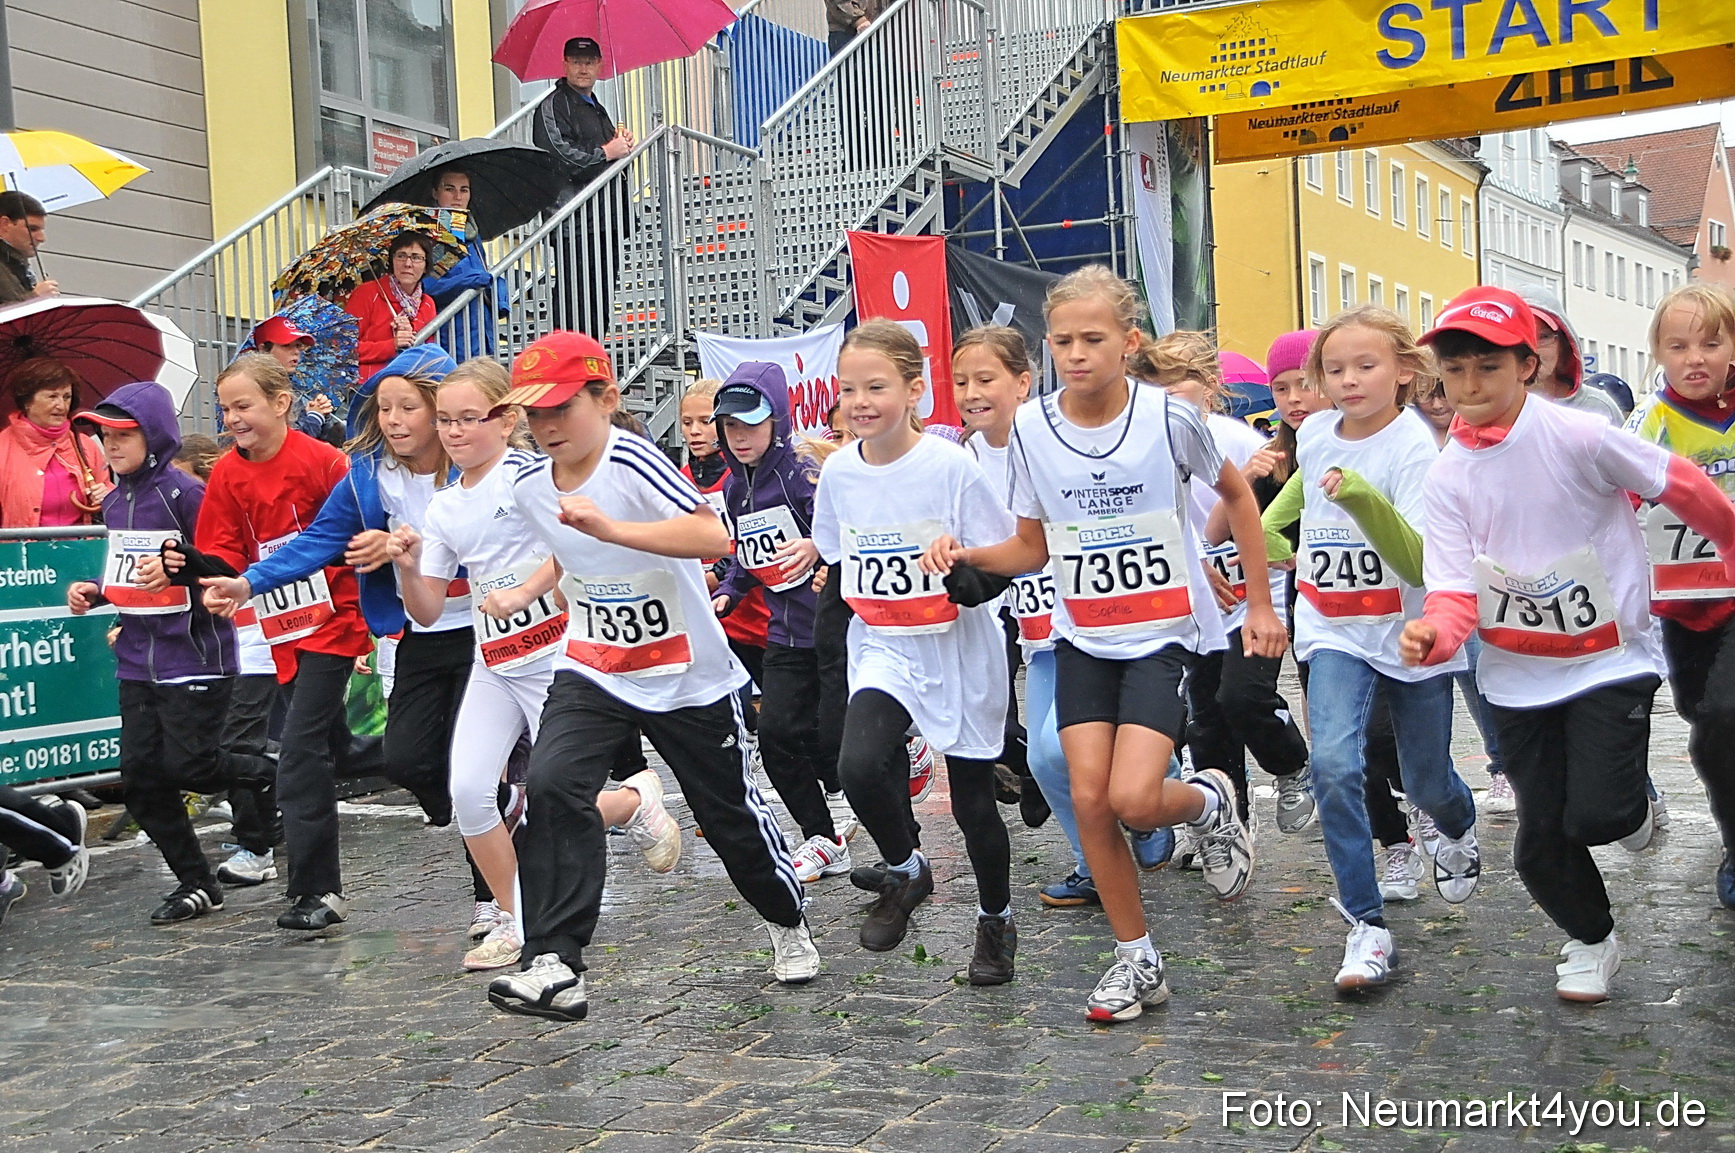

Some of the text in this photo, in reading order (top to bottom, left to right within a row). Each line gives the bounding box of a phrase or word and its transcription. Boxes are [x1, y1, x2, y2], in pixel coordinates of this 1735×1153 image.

[1160, 50, 1328, 84] Neumarkter Stadtlauf
[1248, 100, 1401, 131] Neumarkter Stadtlauf
[396, 143, 408, 152] und
[1073, 483, 1144, 499] INTERSPORT
[1078, 495, 1134, 509] LANGE
[1087, 507, 1124, 516] AMBERG
[739, 517, 767, 532] BOCK
[123, 537, 152, 547] BOCK
[857, 533, 903, 547] BOCK
[1079, 525, 1135, 543] BOCK
[1304, 528, 1350, 540] BOCK
[115, 554, 162, 583] 72
[1062, 544, 1171, 594] 7365
[585, 583, 633, 596] BOCK
[1505, 571, 1559, 593] BOCK
[1088, 602, 1132, 618] Sophie
[1488, 585, 1597, 632] 7313
[278, 611, 313, 631] Leonie
[576, 599, 670, 643] 7339
[0, 632, 76, 669] rheit
[25, 743, 81, 770] 09181
[87, 737, 121, 760] 635
